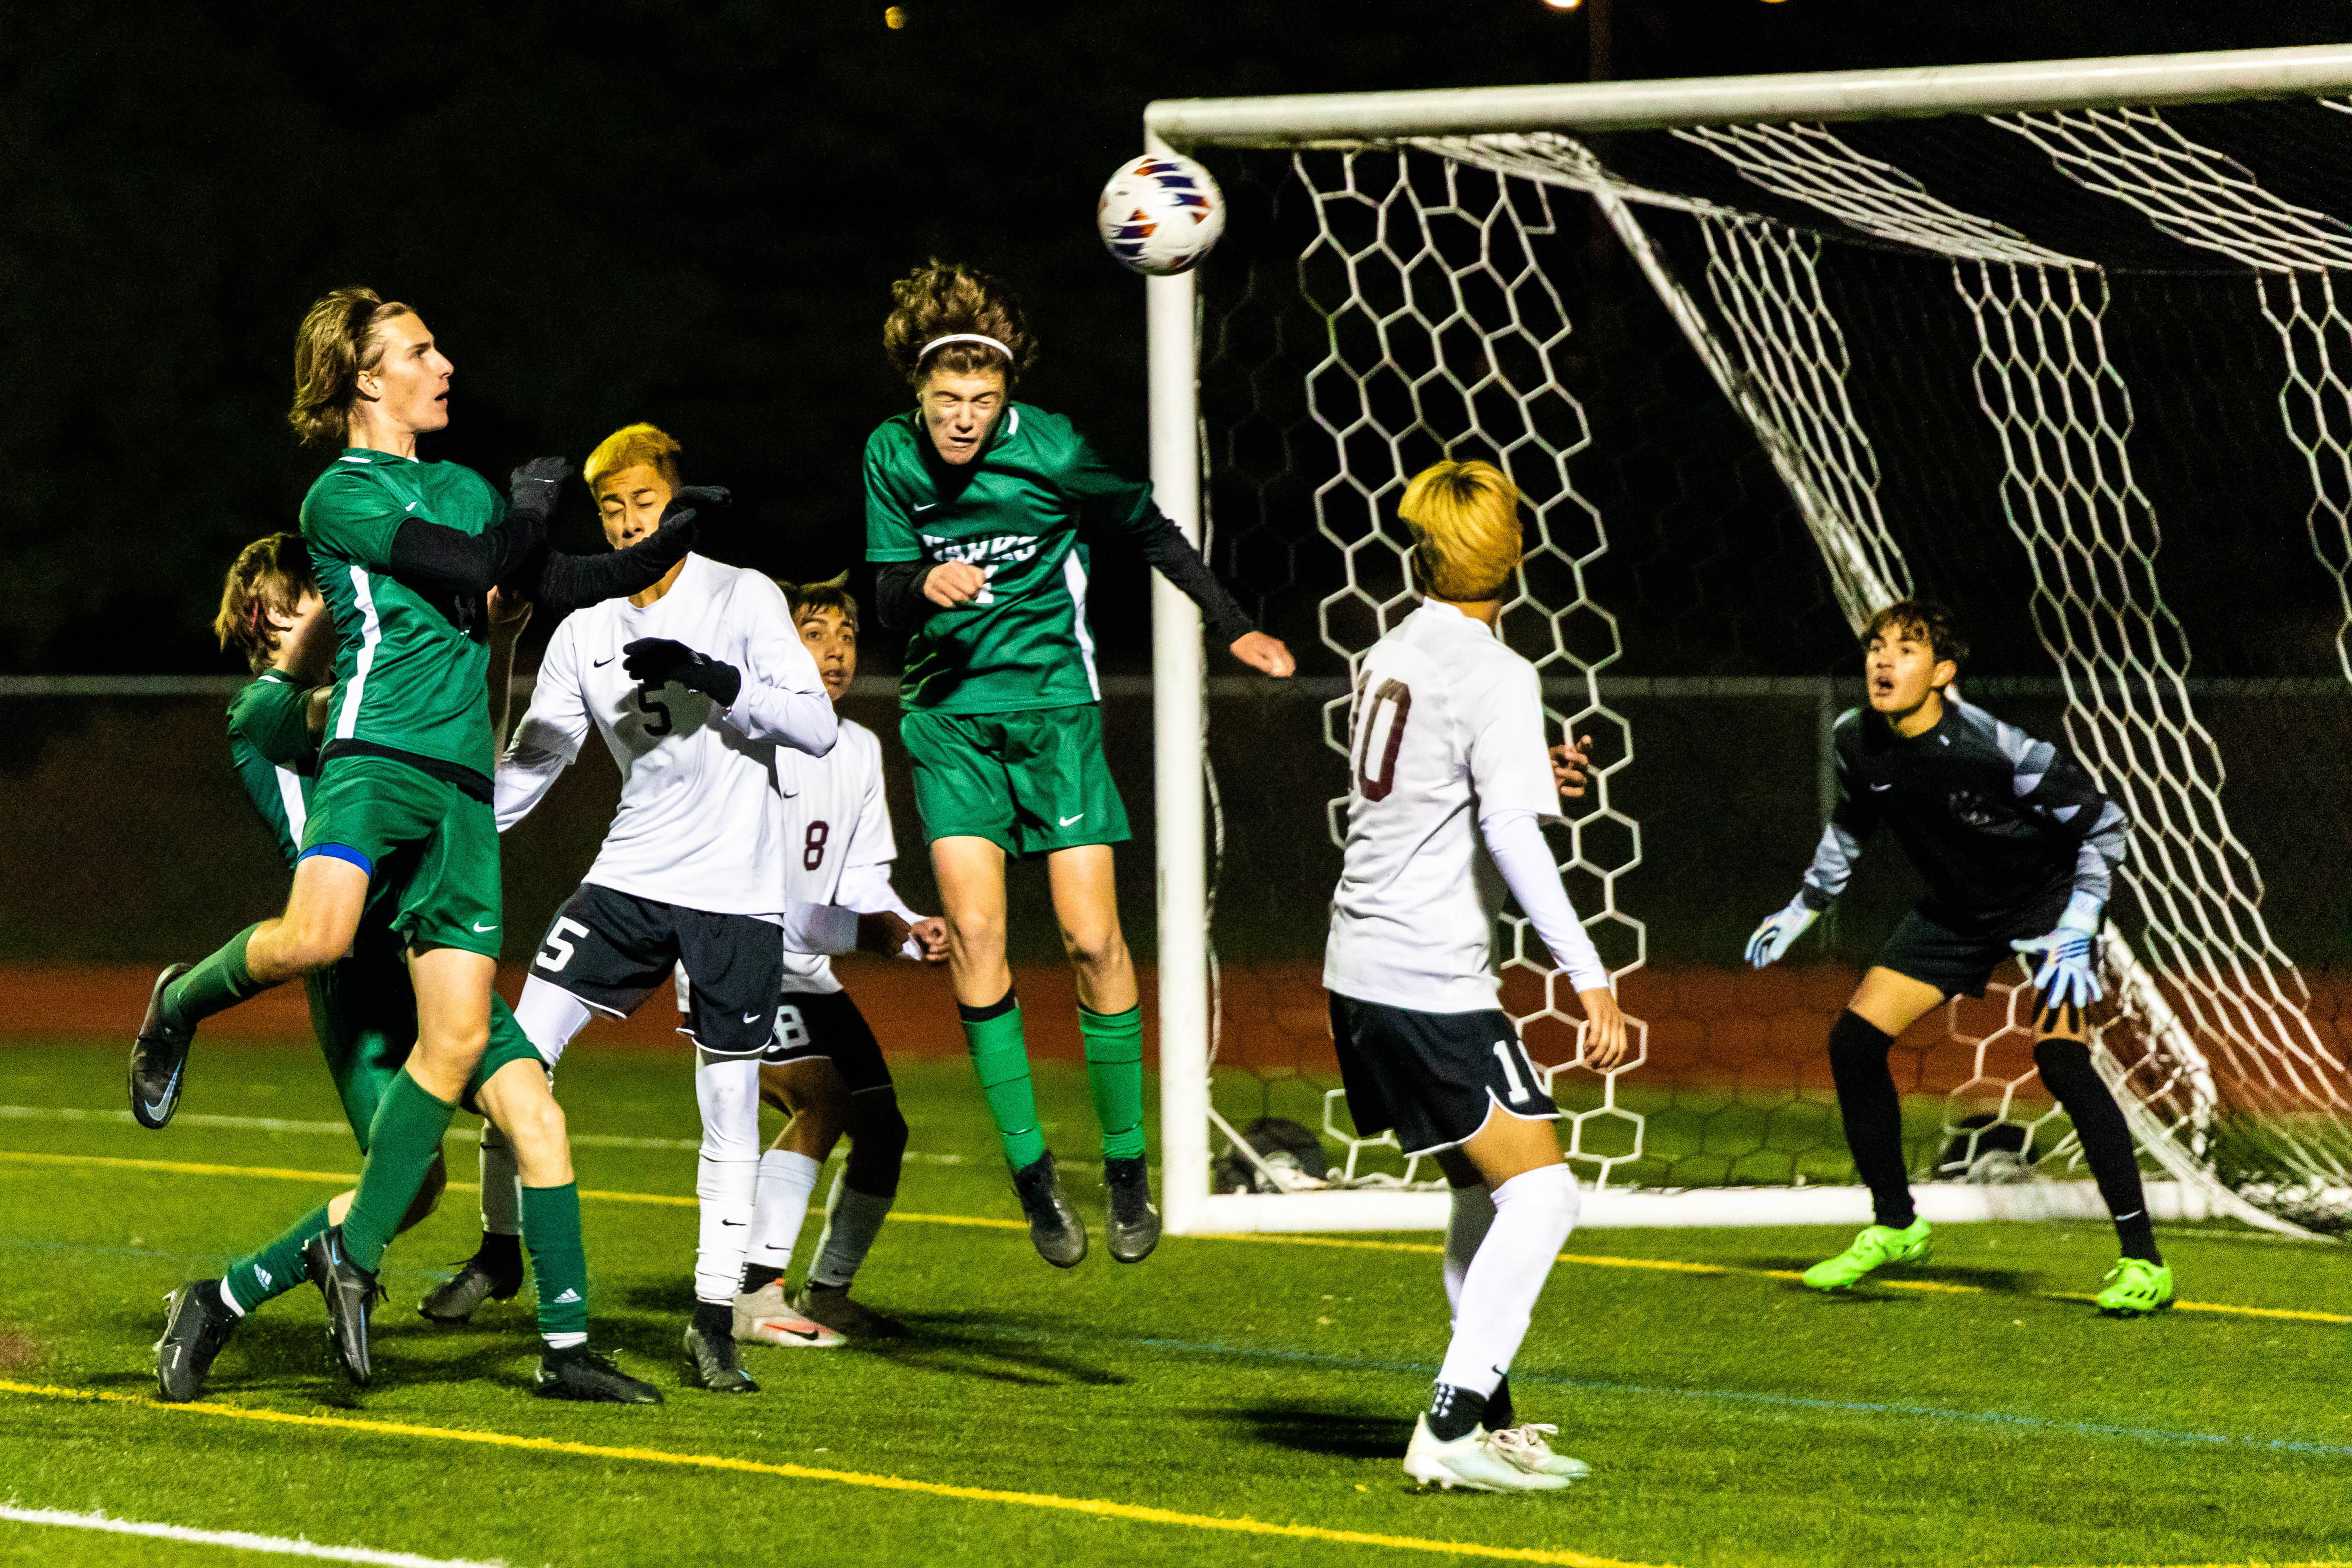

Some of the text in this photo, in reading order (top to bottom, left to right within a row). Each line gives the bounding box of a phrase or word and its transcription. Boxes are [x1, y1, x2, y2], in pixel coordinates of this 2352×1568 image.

[638, 683, 672, 736] 5
[803, 820, 829, 871] 8
[535, 915, 590, 972] 5
[774, 1004, 811, 1049] 8
